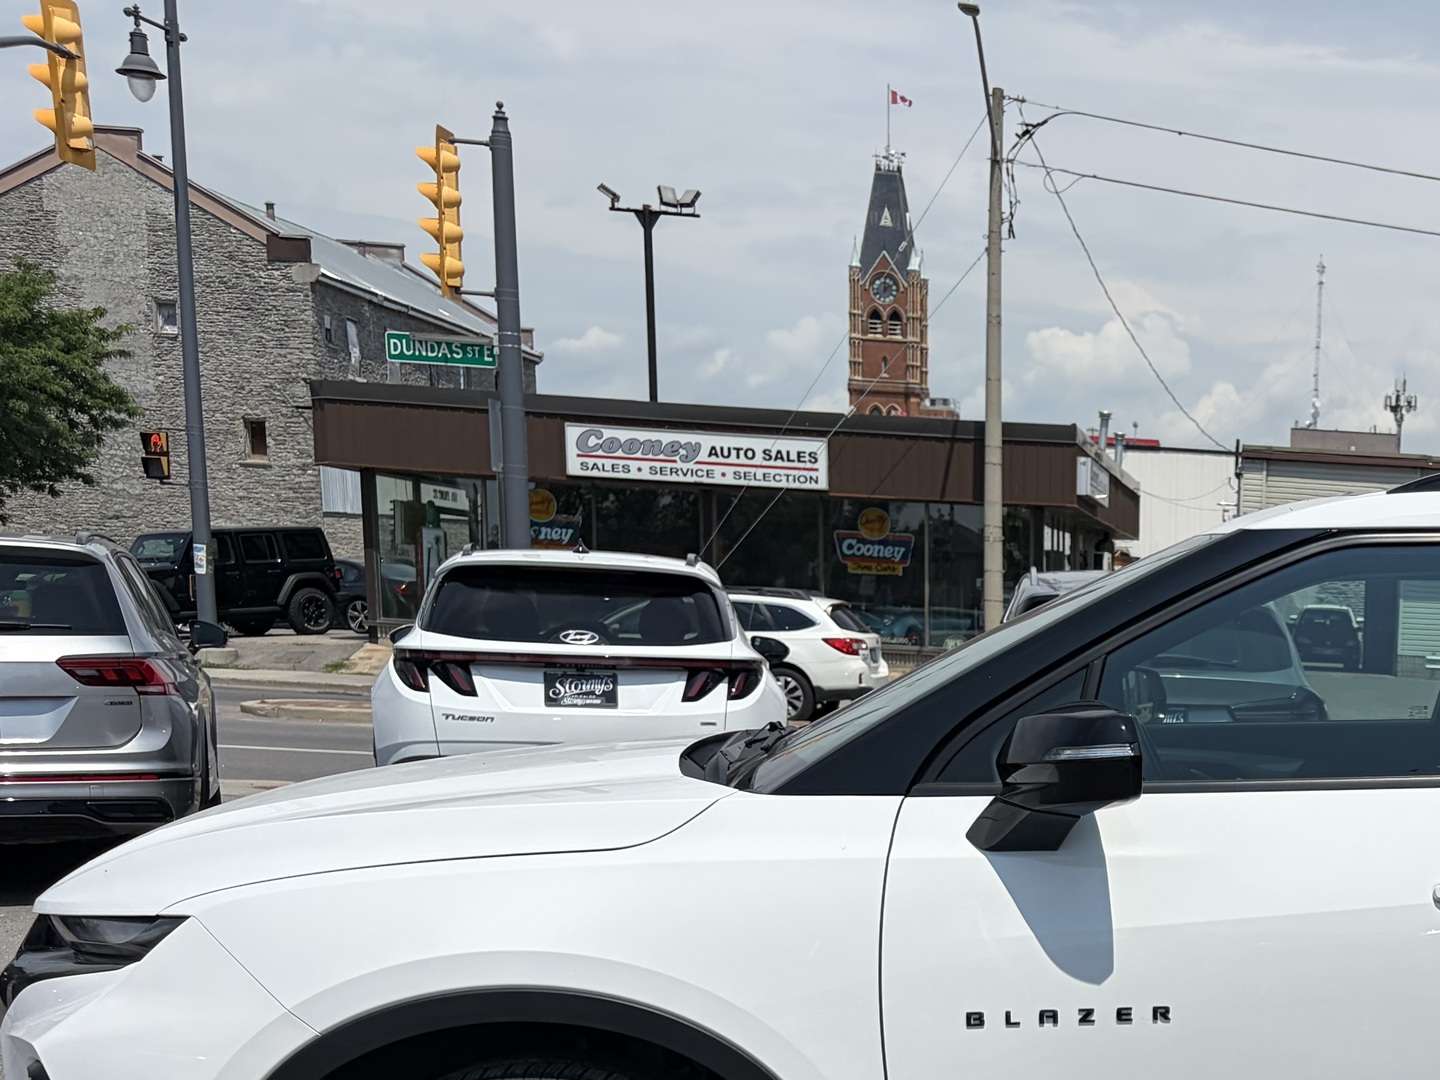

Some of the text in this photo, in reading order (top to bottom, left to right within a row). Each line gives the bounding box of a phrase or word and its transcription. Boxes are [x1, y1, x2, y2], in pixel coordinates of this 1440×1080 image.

[389, 338, 493, 361] DUNDAS ST E
[576, 428, 818, 465] Cooney AUTO SALES
[580, 461, 819, 485] SALES SERVICE SELECTION
[842, 538, 906, 562] Cooney
[965, 1005, 1171, 1030] BLAZER
